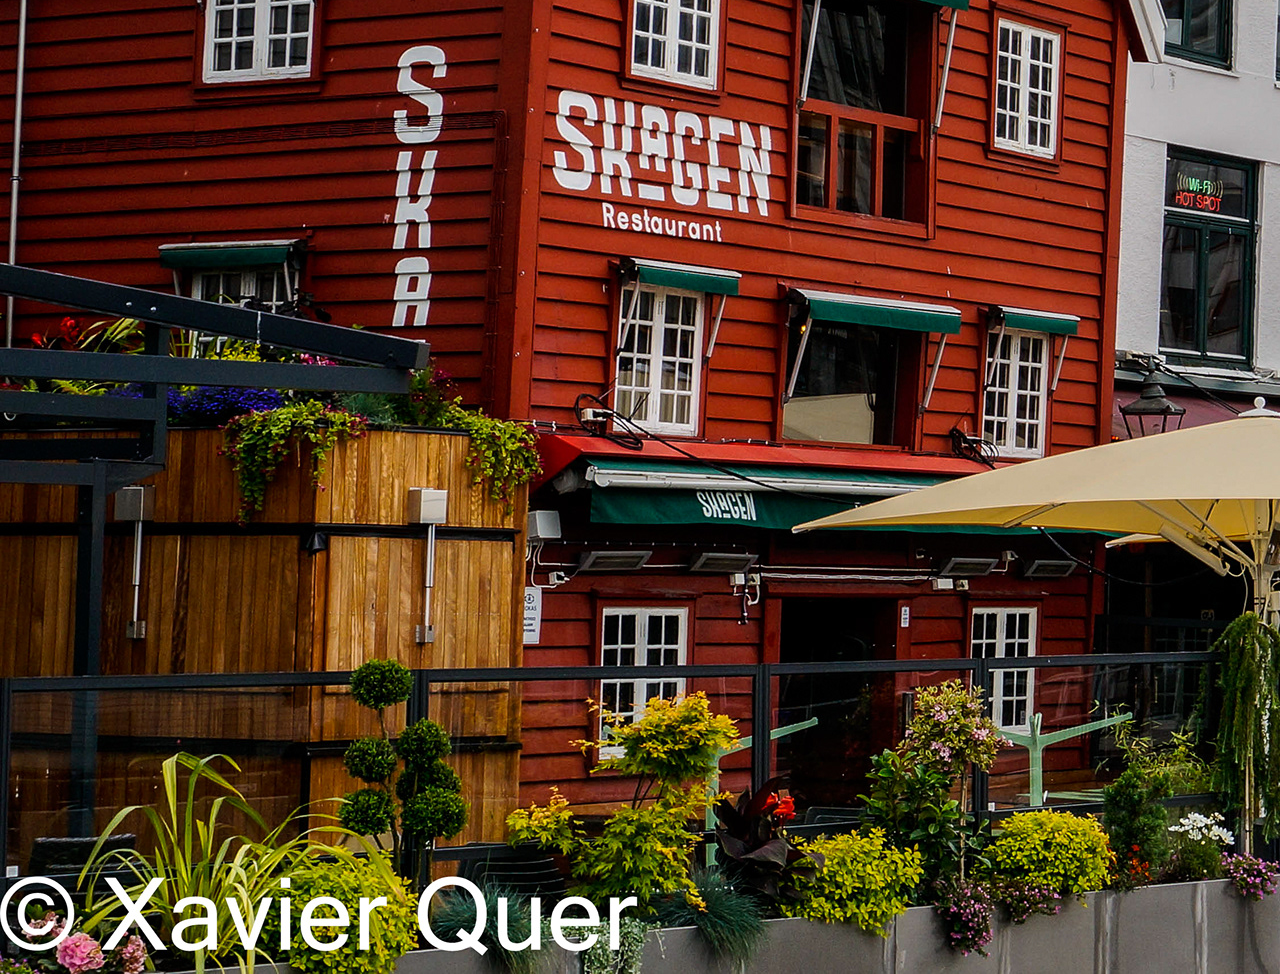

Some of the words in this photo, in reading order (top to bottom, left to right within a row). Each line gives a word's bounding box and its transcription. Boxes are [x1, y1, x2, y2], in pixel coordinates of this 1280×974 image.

[552, 90, 772, 217] SKAGEN
[392, 45, 447, 326] SKA
[1176, 191, 1195, 206] HOT
[1196, 194, 1221, 212] SPOT
[1188, 177, 1211, 195] Wi-Fi
[601, 202, 723, 242] Restaurant
[696, 491, 757, 521] SKAGEN
